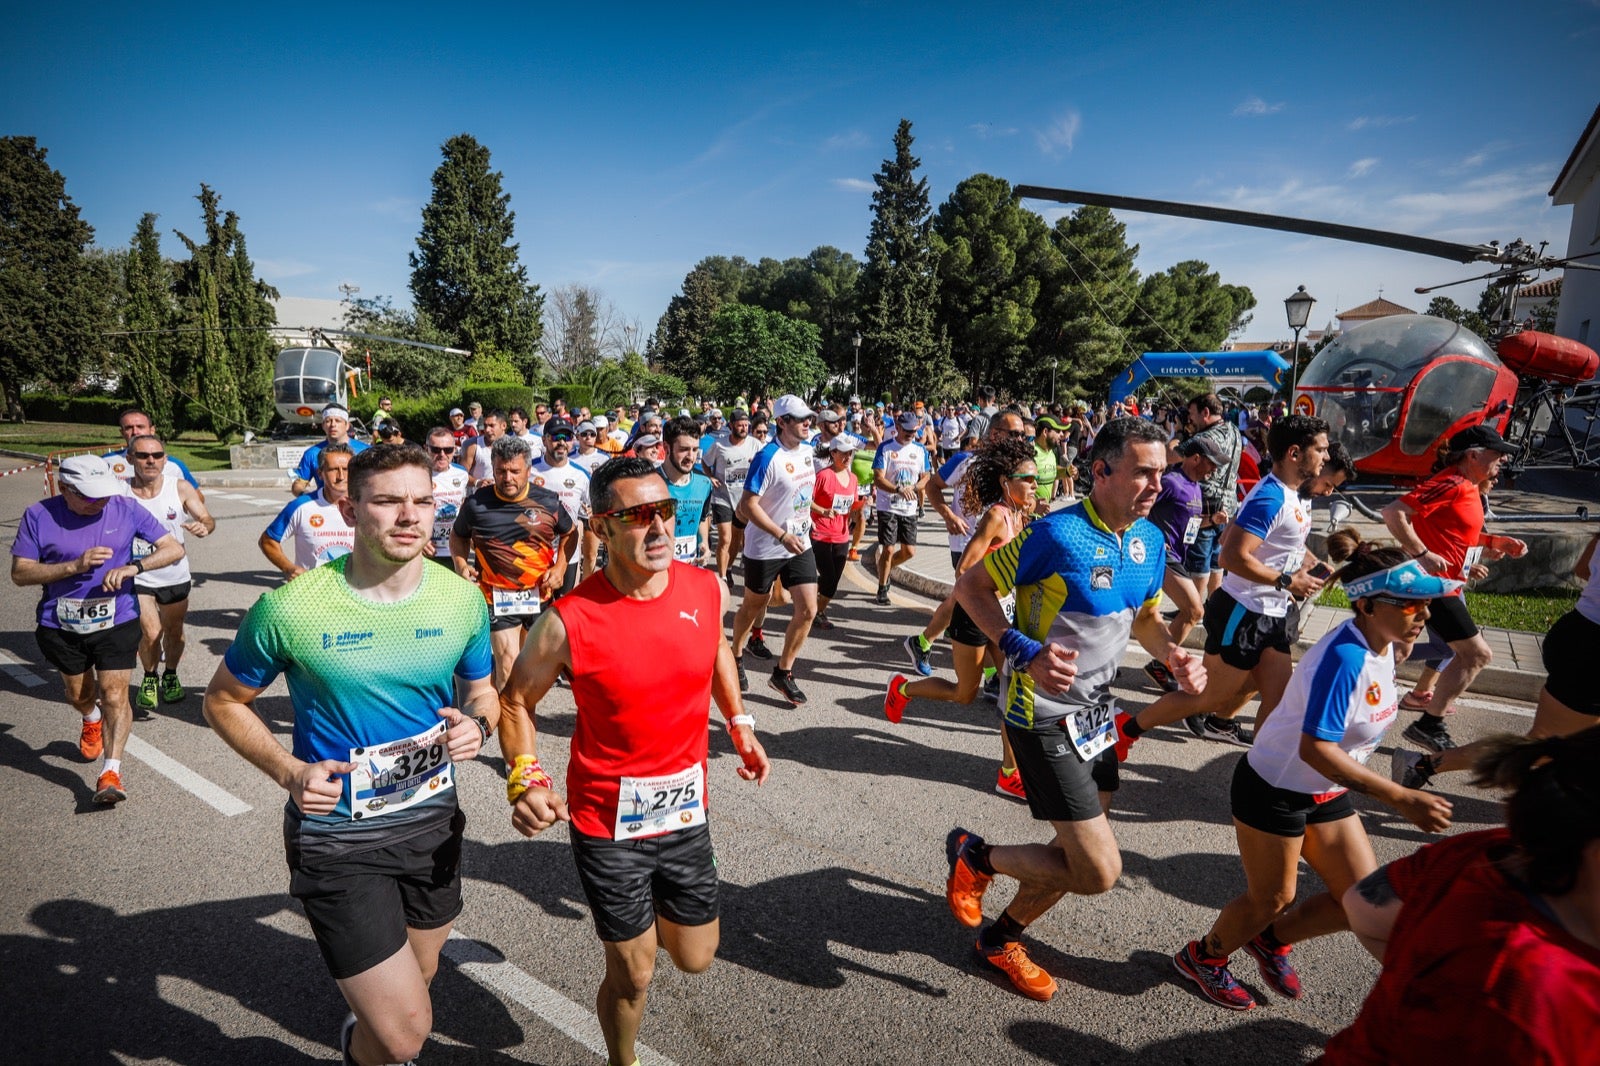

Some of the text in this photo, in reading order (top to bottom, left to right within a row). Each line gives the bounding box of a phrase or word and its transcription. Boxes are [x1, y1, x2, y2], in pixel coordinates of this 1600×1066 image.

[1160, 365, 1198, 374] EJÉRCITO
[675, 543, 689, 555] 31
[77, 604, 109, 619] 165
[336, 631, 373, 641] olimpo
[1086, 703, 1110, 730] 122
[378, 742, 412, 755] CARRERA
[394, 744, 443, 780] 329
[652, 782, 696, 811] 275
